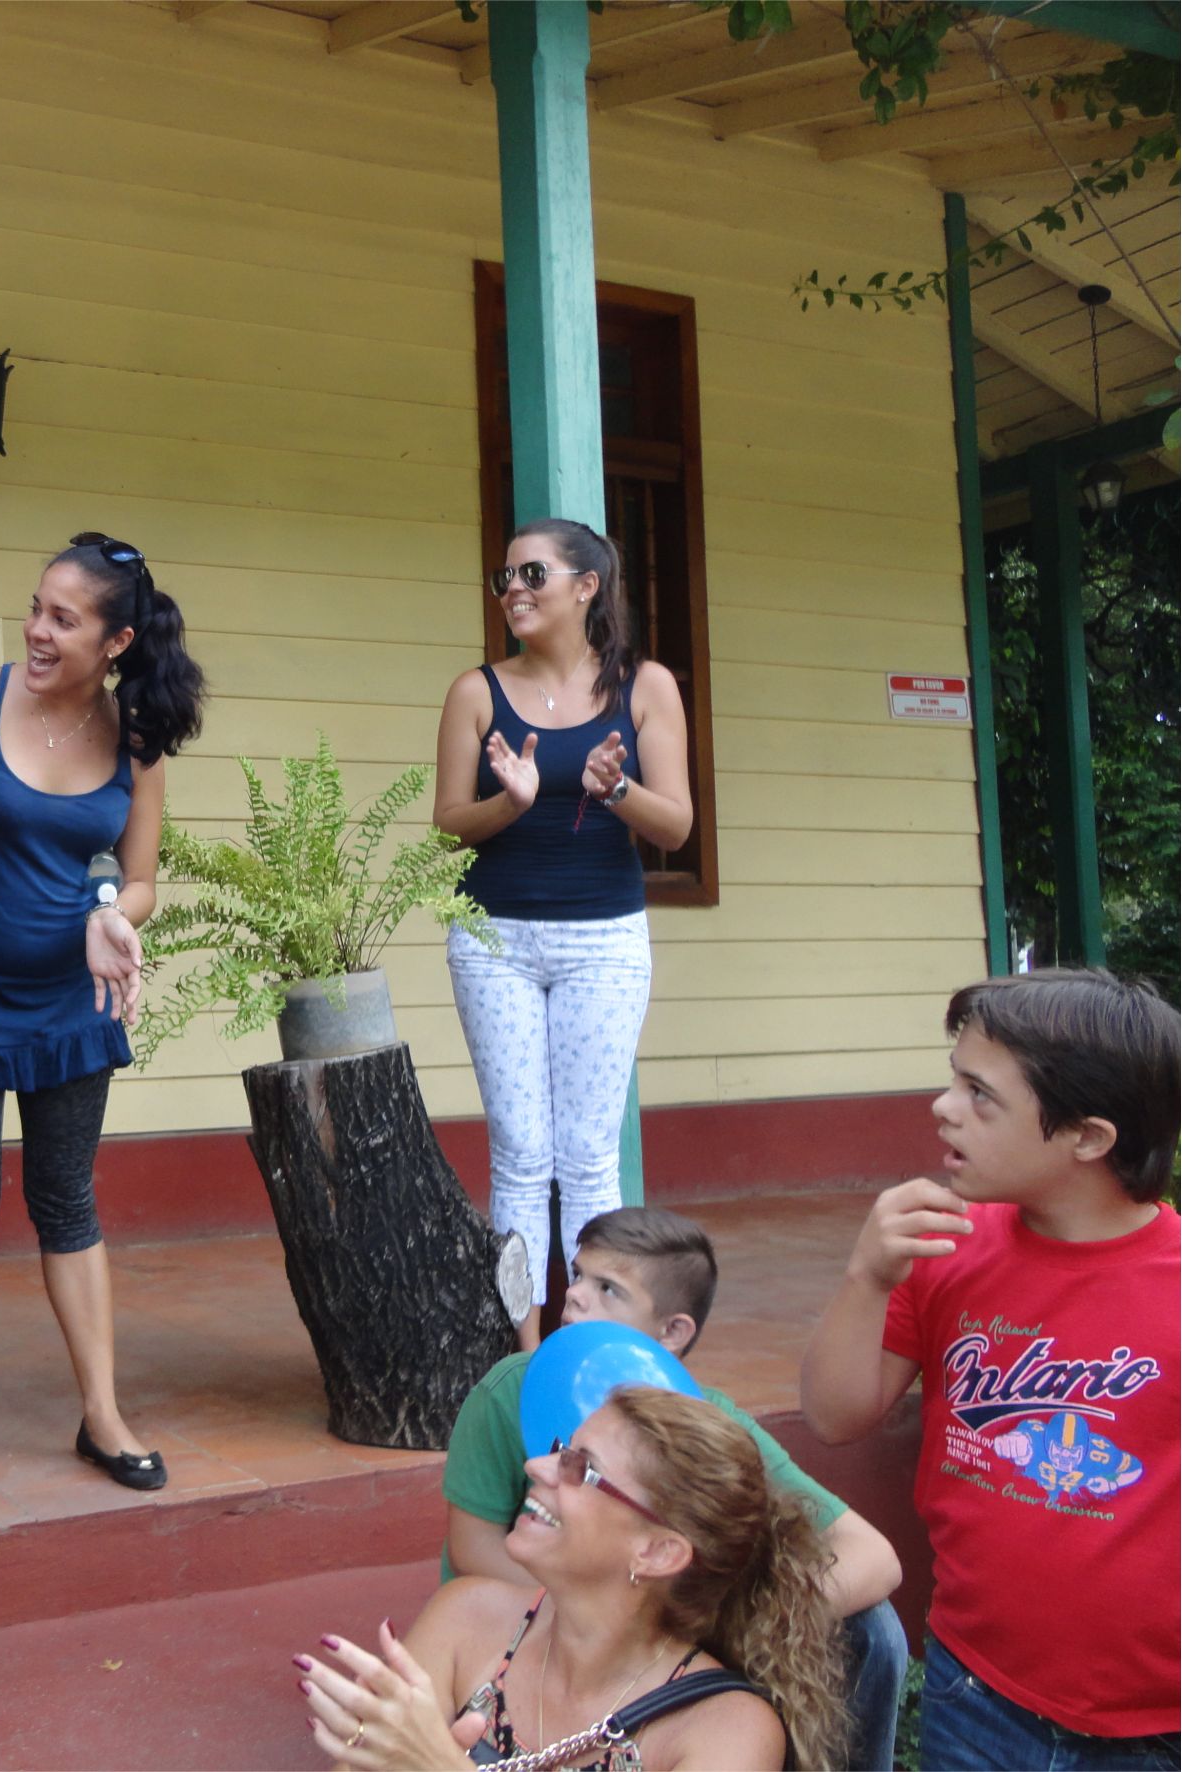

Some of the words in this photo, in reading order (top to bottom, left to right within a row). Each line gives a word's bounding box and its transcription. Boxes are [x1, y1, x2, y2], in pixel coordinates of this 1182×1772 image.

[943, 1333, 1161, 1406] Ontario
[945, 1435, 967, 1451] THE
[967, 1443, 982, 1457] TOP
